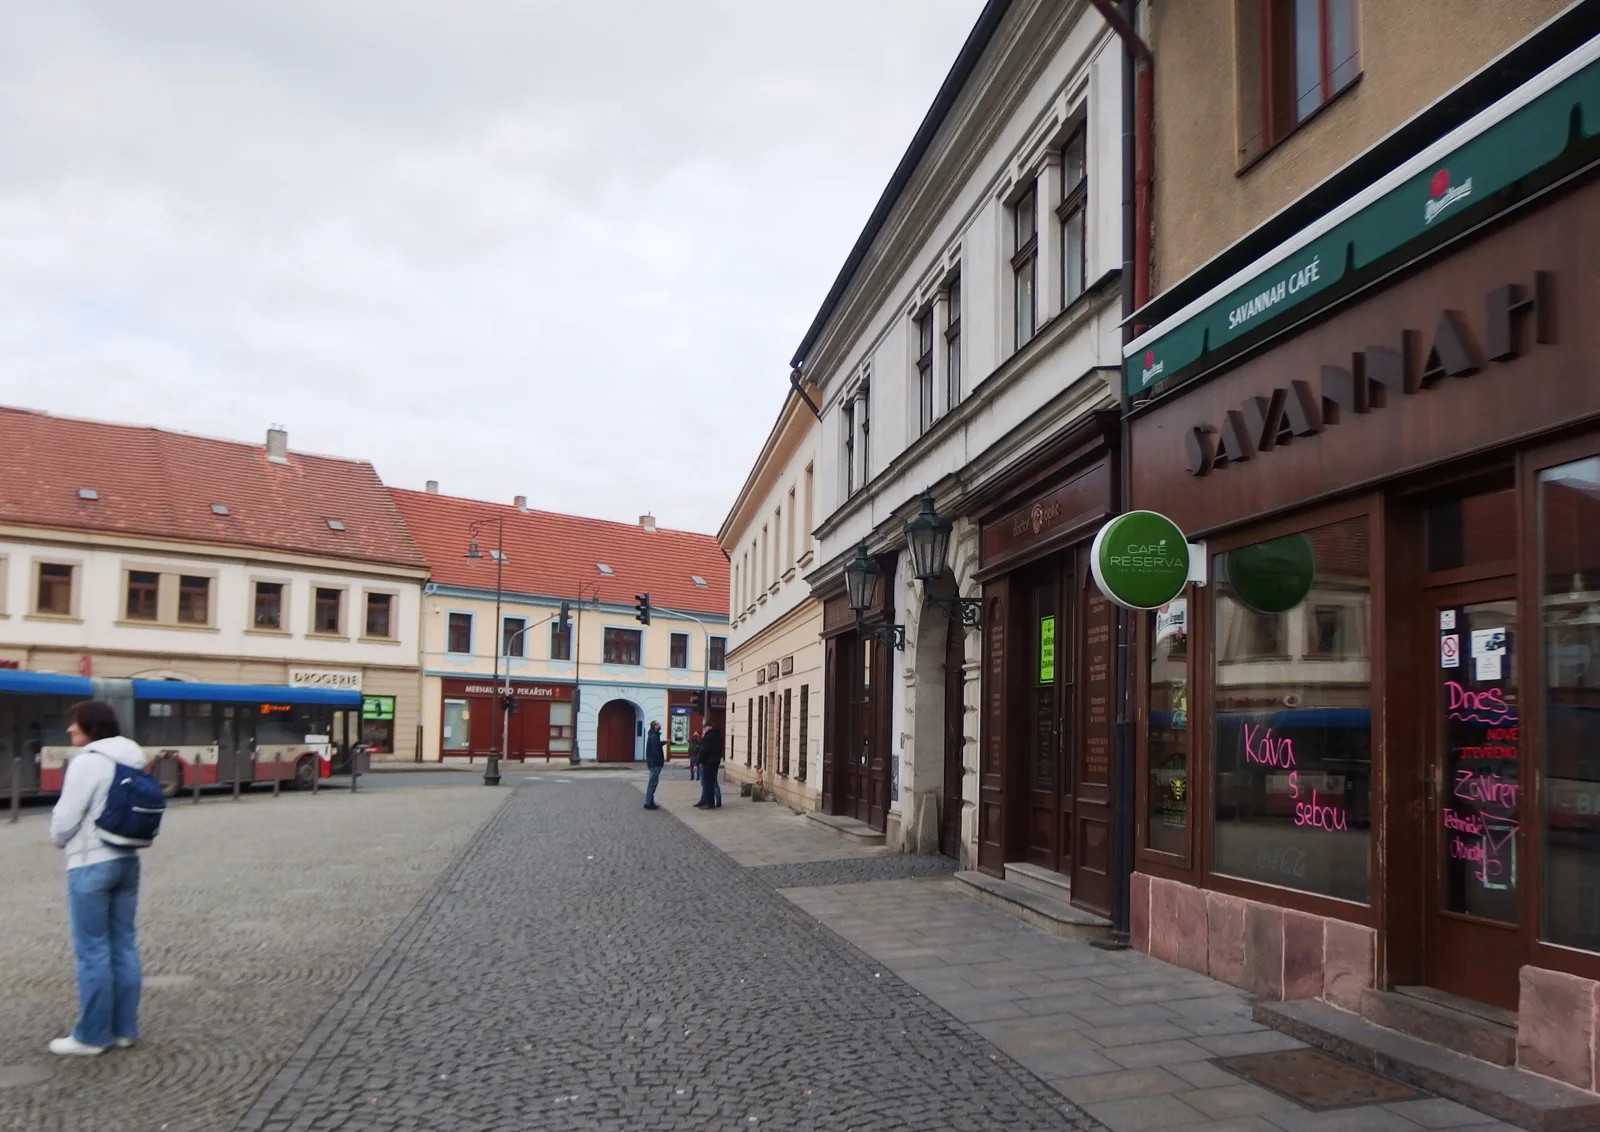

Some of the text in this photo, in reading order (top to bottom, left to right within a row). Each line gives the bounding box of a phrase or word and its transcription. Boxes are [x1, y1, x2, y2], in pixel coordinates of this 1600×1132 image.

[1229, 255, 1321, 329] SAVANNAH CAFÉ
[1185, 269, 1560, 477] SAVANNAH
[1110, 556, 1184, 568] RESERVA
[1127, 540, 1167, 556] CAFÉ
[294, 672, 357, 686] DROGERIE
[465, 685, 552, 697] MERHAUOVO PEKAŘSTVÍ
[1444, 681, 1509, 714] Dnes
[1244, 723, 1296, 768] Káva
[1294, 789, 1348, 832] sebou
